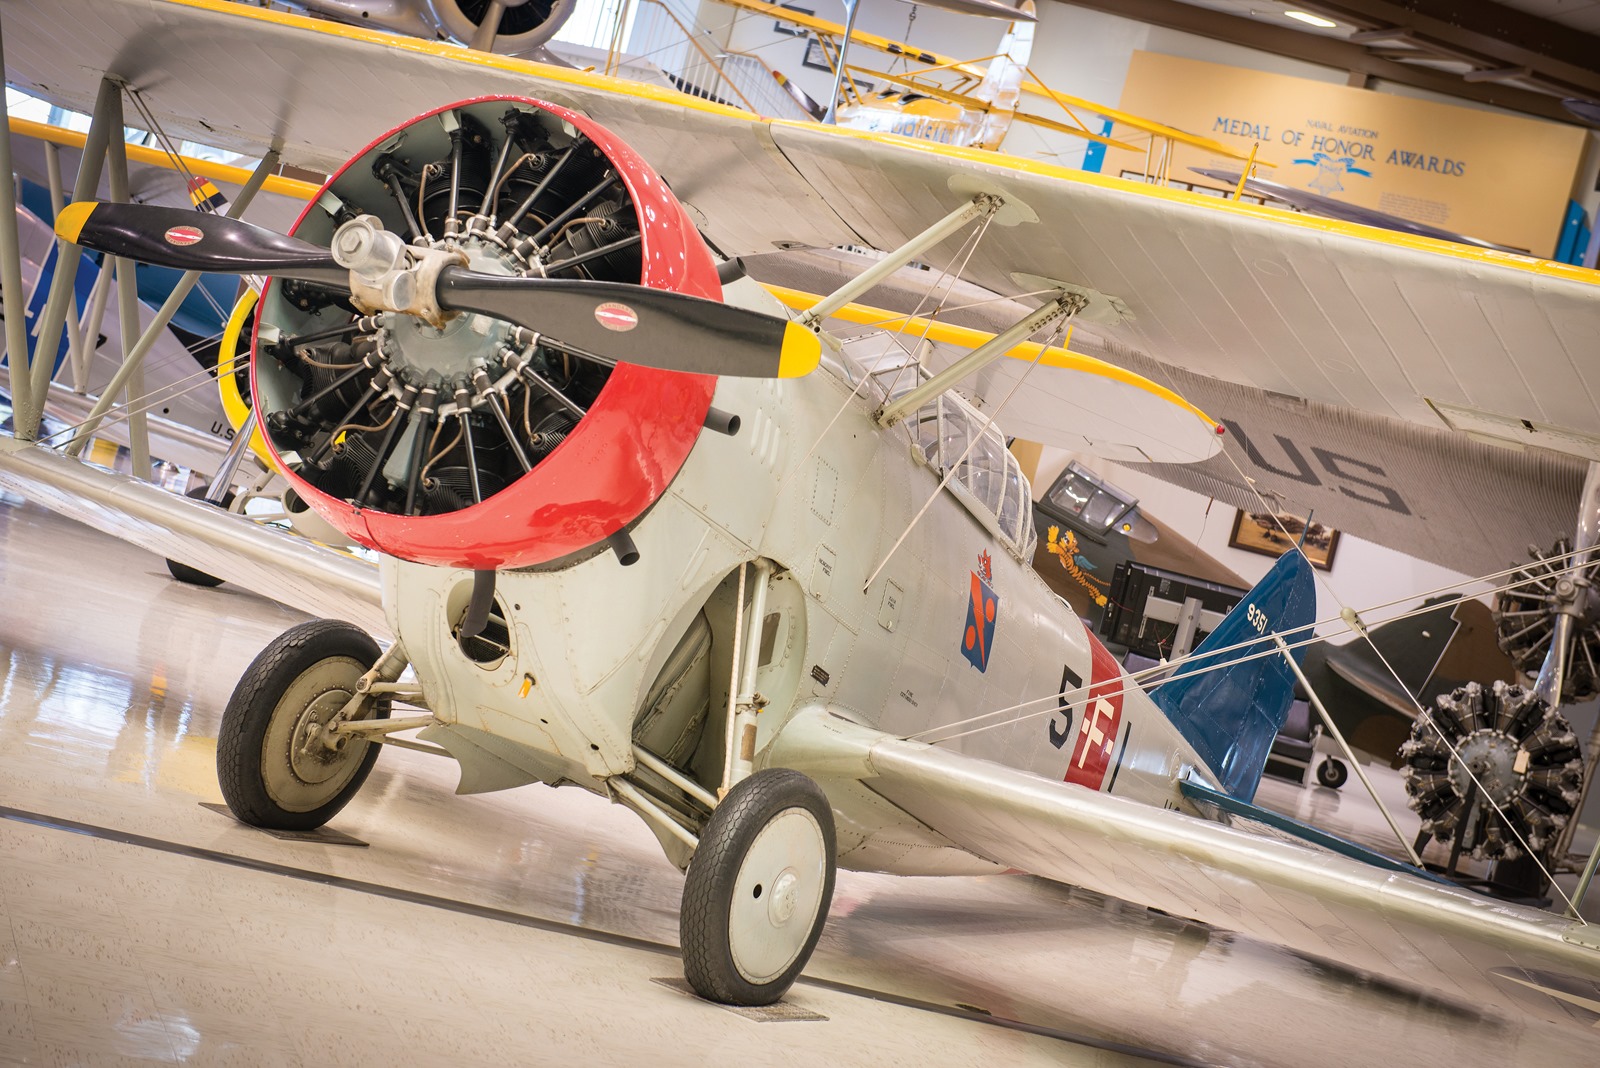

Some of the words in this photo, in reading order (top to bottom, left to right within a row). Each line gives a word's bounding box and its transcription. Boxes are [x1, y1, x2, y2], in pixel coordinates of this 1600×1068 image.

[1306, 119, 1334, 131] NAVAL
[1338, 124, 1378, 139] AVIATION
[1212, 116, 1272, 142] MEDAL
[1281, 129, 1305, 147] OF
[1310, 135, 1376, 161] HONOR
[1385, 149, 1466, 177] AWARDS
[1247, 603, 1269, 635] 9351
